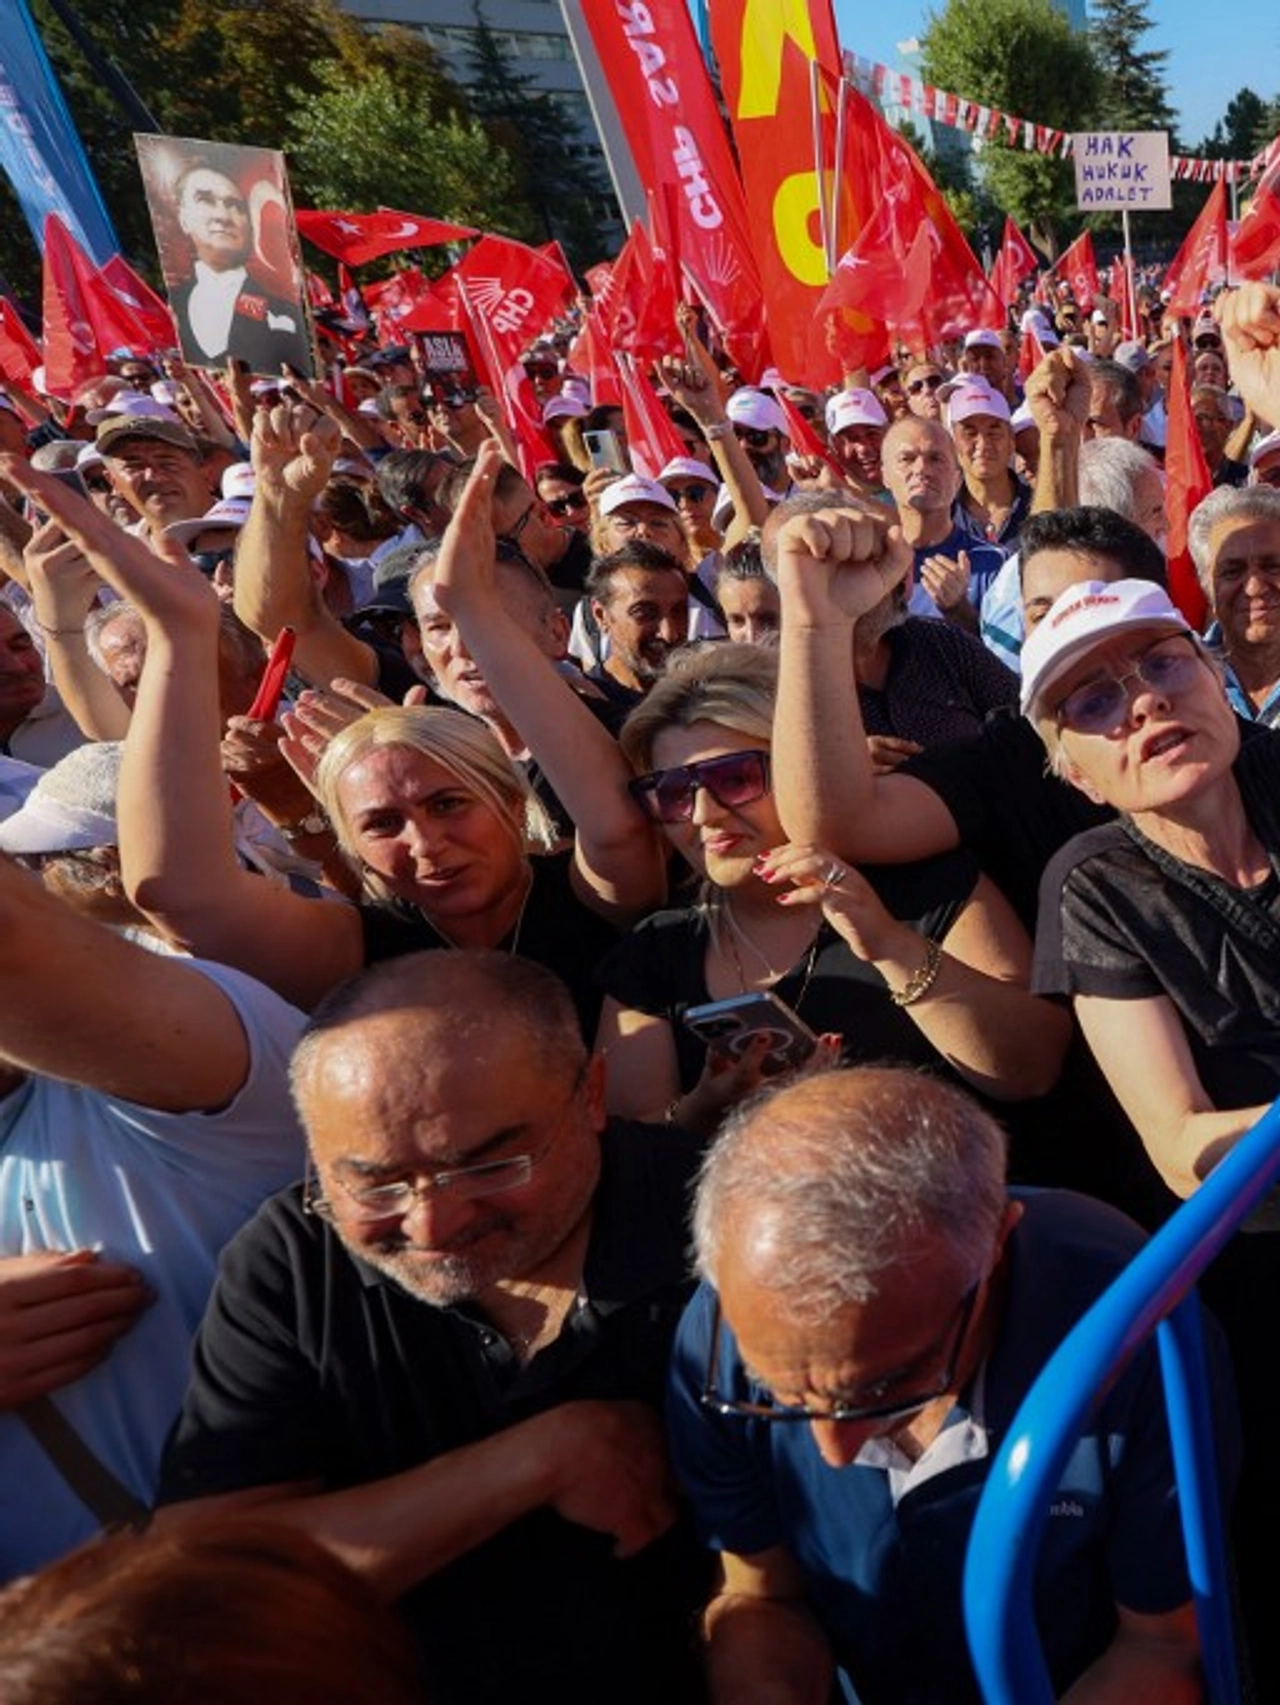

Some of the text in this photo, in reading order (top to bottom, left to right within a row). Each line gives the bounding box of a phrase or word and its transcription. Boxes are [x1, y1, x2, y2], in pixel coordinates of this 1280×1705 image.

[1085, 136, 1134, 158] HAK
[1082, 161, 1148, 181] HUKUK
[1083, 187, 1153, 202] ADALET
